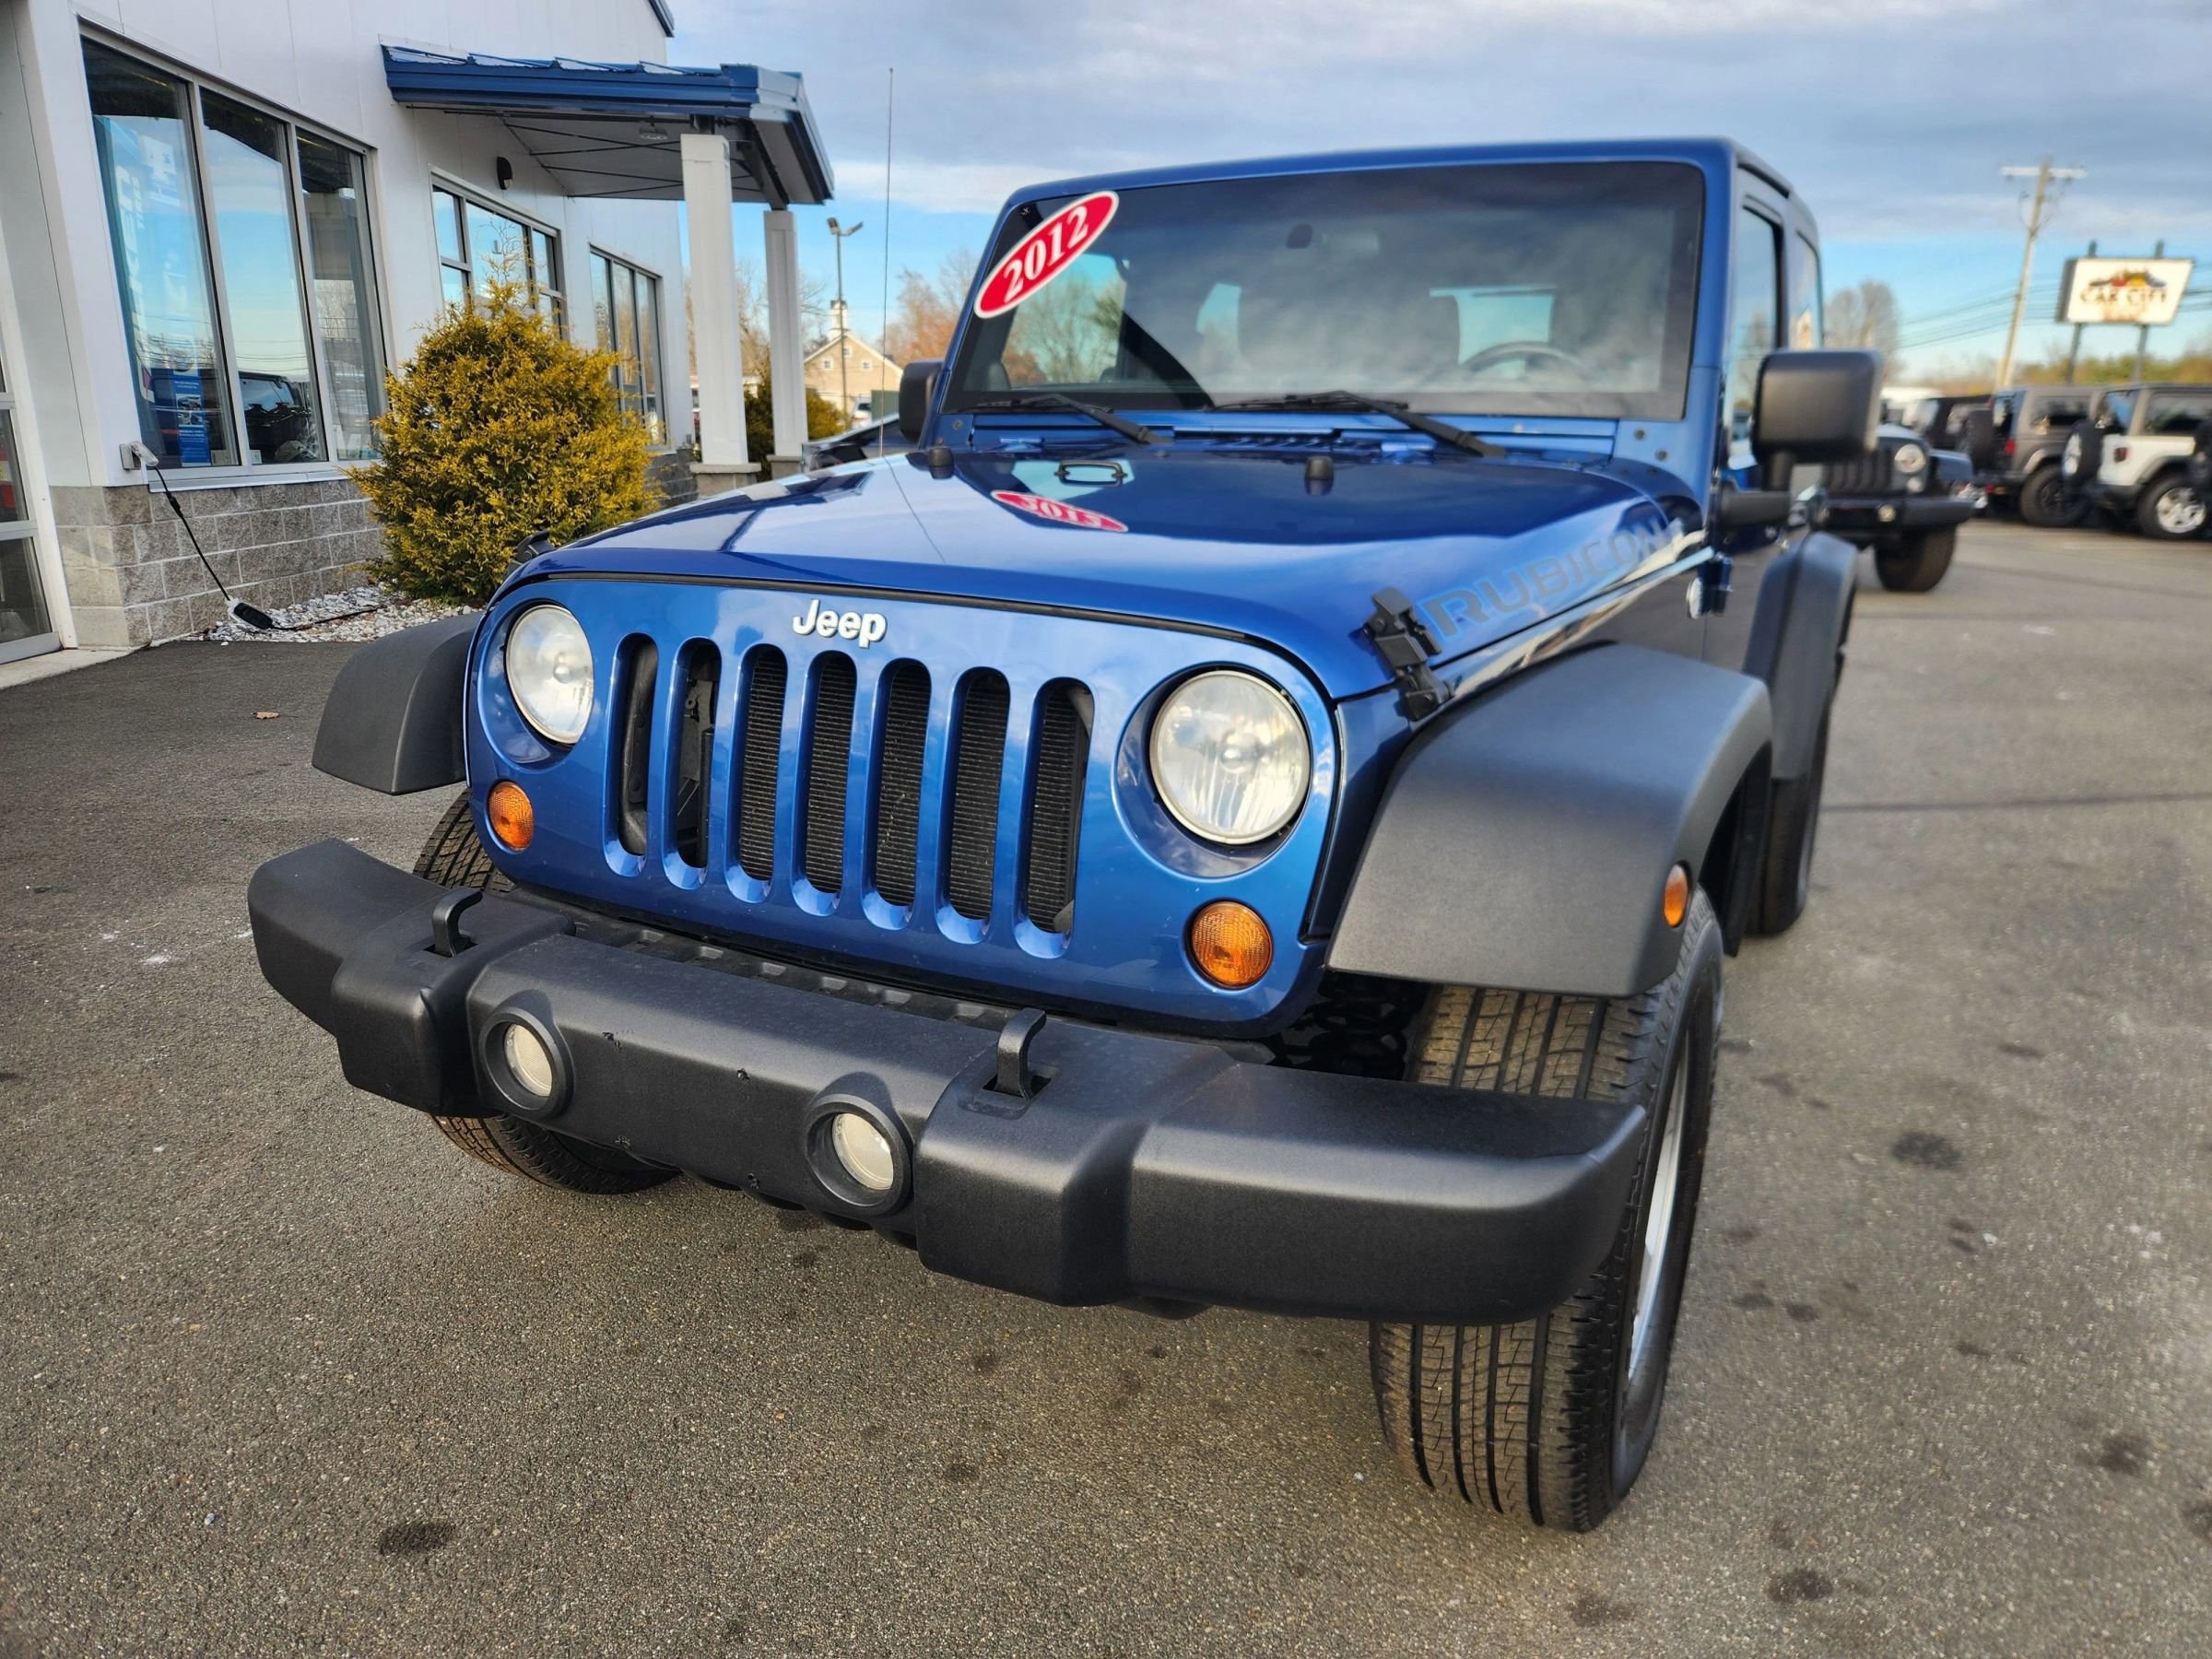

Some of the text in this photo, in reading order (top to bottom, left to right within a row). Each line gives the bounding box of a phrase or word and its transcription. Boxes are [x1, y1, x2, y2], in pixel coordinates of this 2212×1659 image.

[1003, 205, 1089, 304] 2012
[792, 598, 888, 649] Jeep
[1416, 519, 1670, 641] RUBICON
